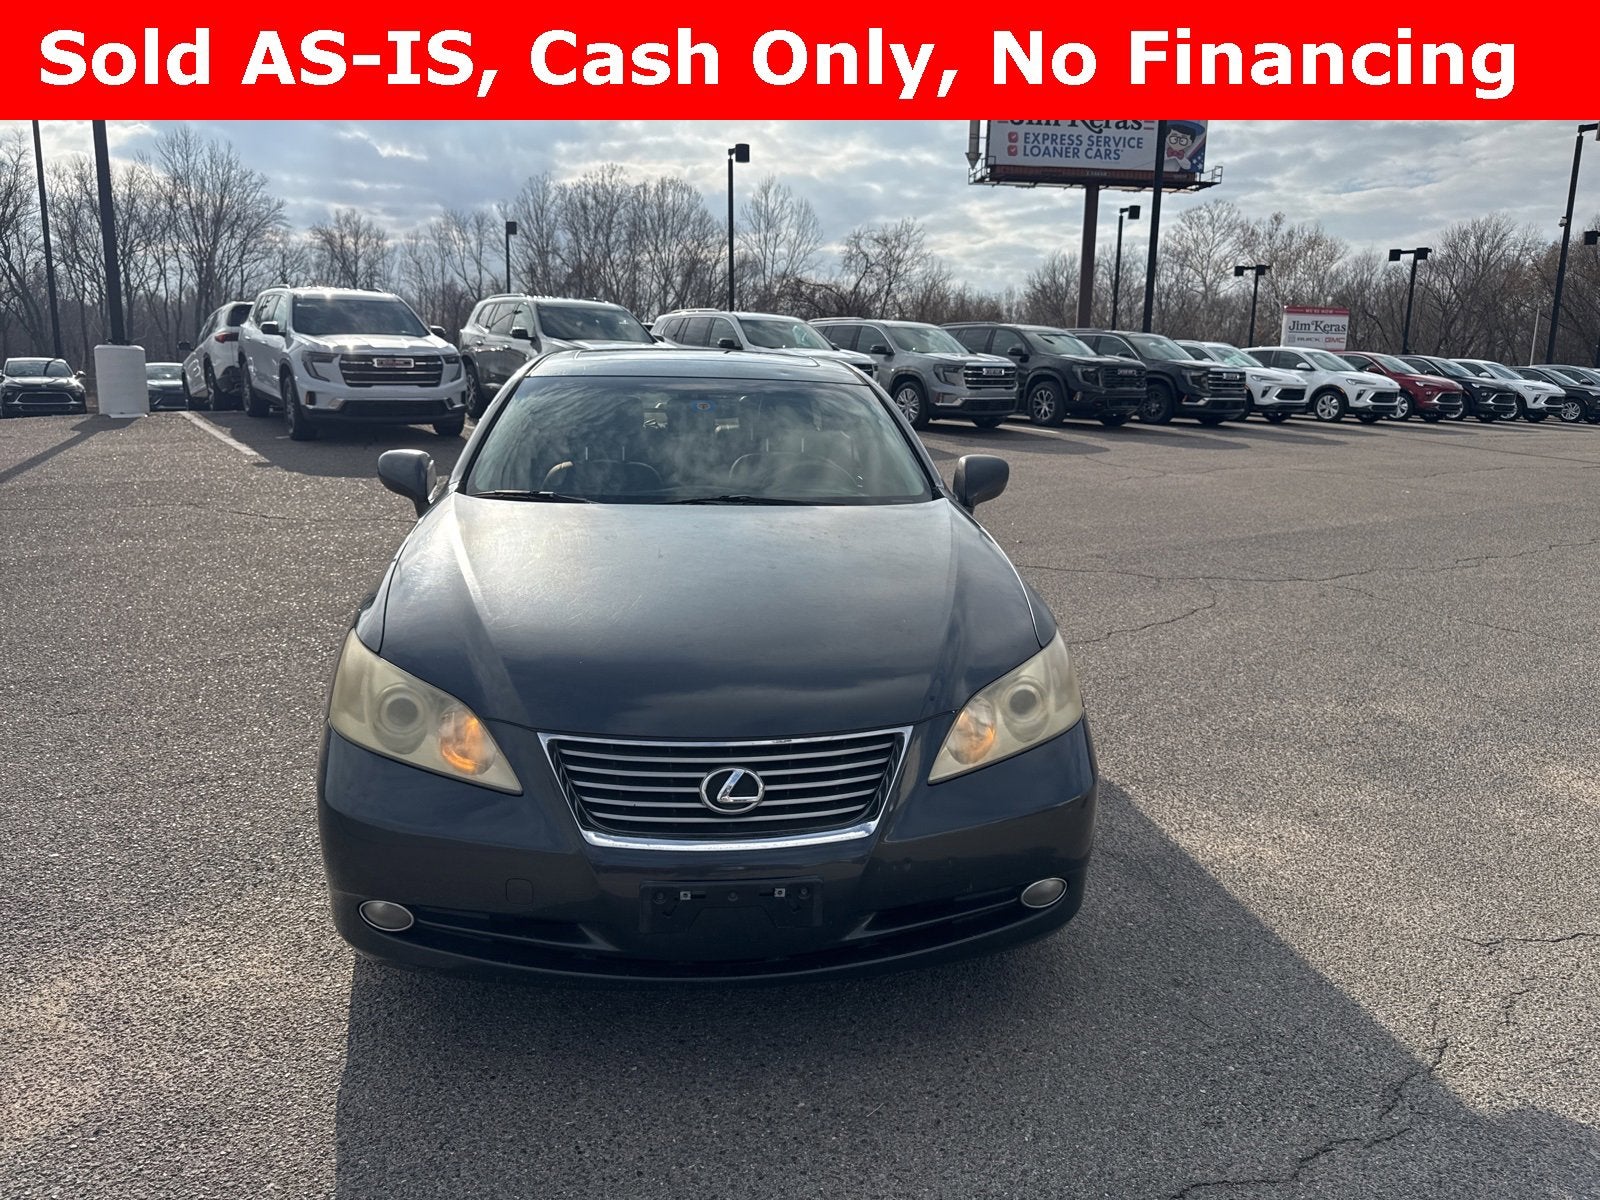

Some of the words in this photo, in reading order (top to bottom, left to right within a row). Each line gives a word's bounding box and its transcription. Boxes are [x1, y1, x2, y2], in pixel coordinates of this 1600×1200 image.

[1023, 132, 1083, 147] EXPRESS
[1086, 134, 1143, 149] SERVICE
[1023, 145, 1080, 159] LOANER
[1288, 320, 1310, 331] Jim
[1311, 320, 1347, 335] Keras
